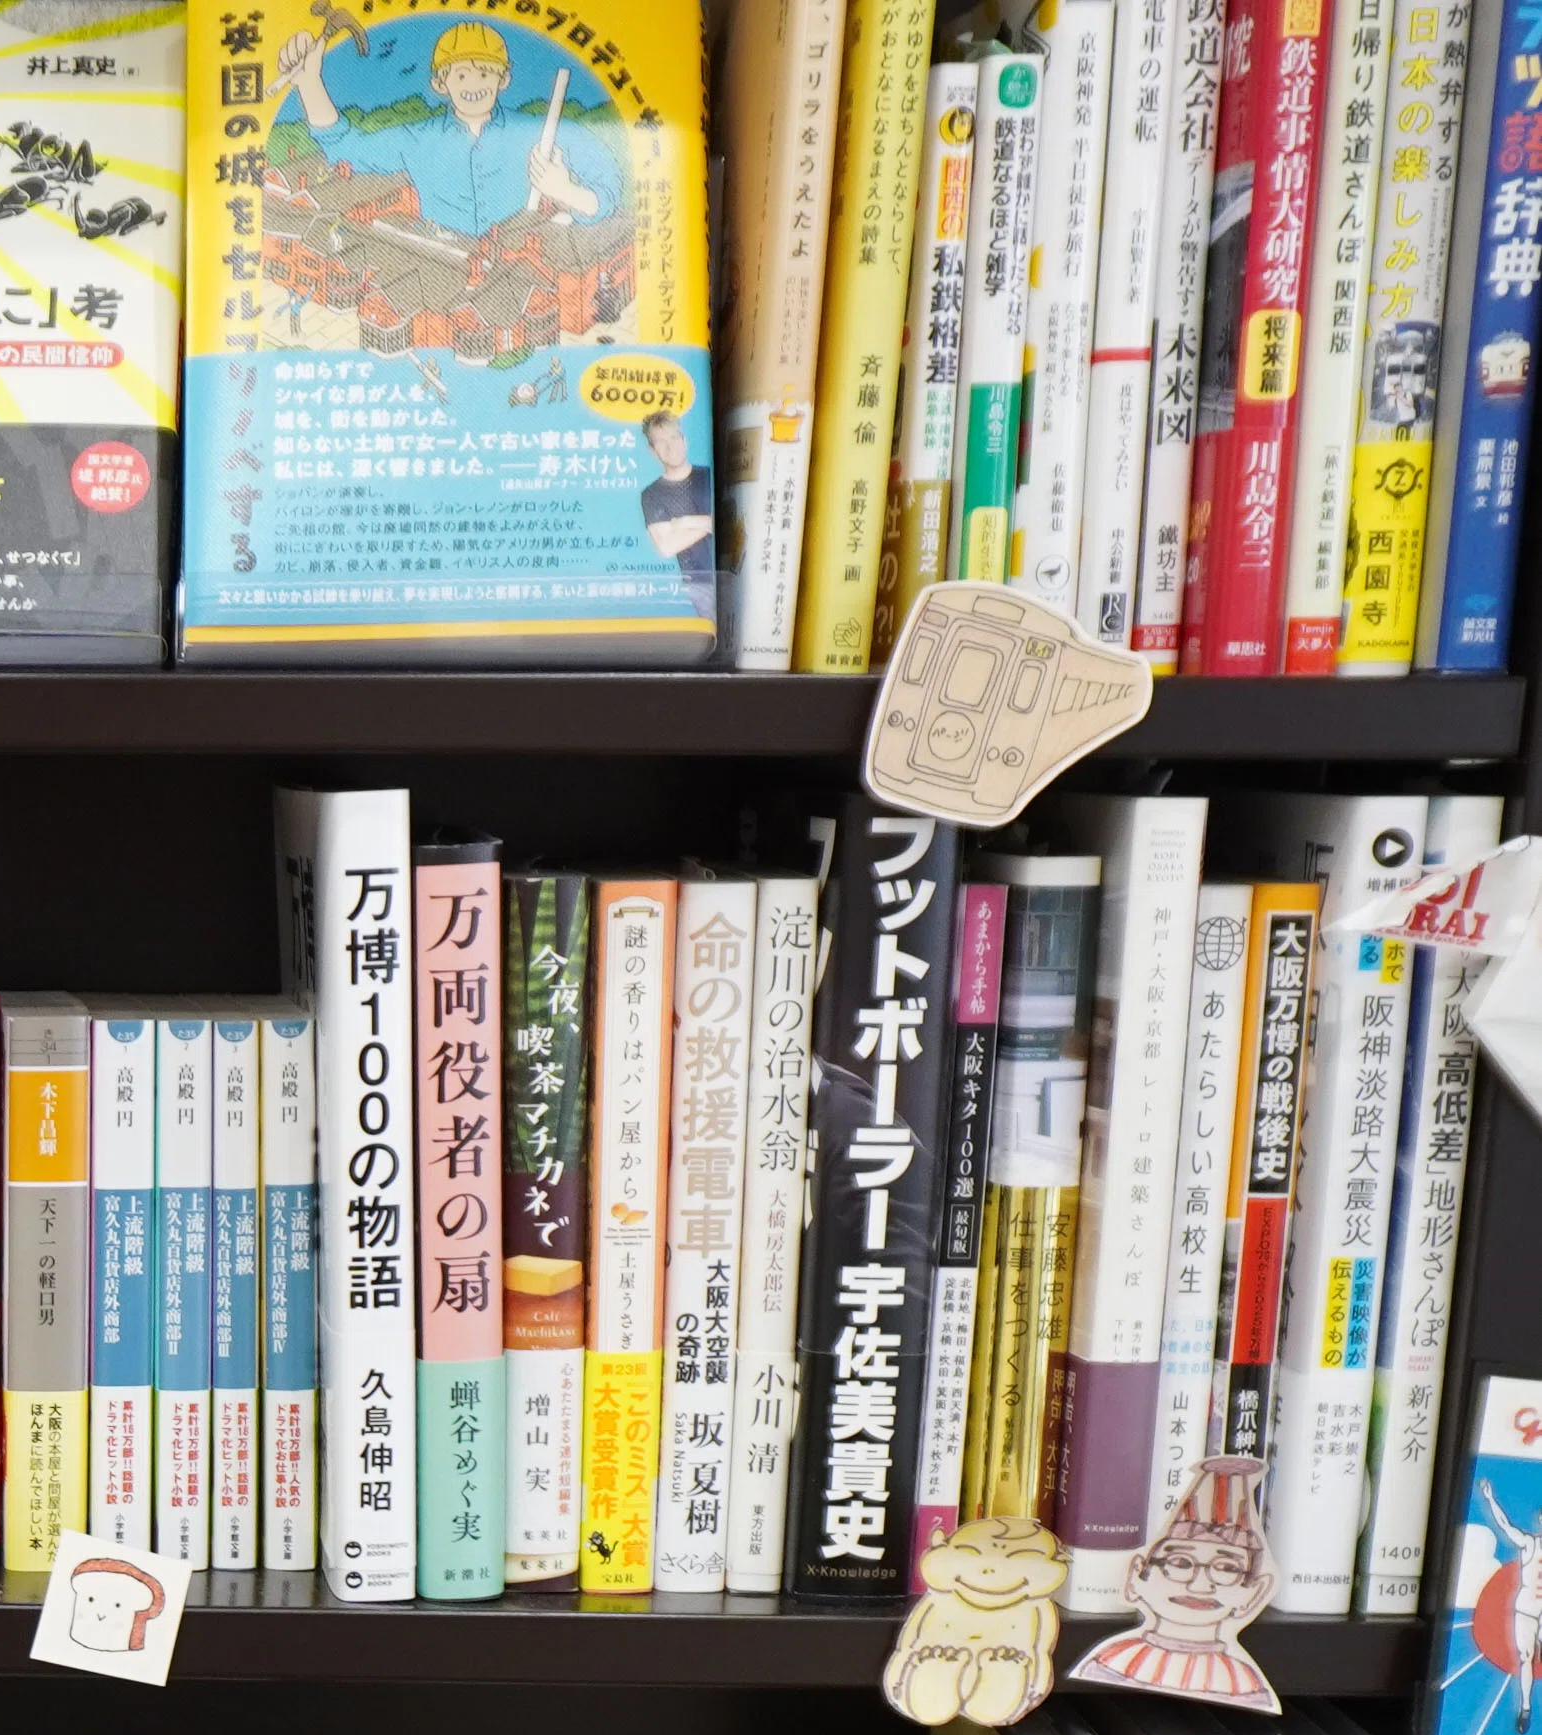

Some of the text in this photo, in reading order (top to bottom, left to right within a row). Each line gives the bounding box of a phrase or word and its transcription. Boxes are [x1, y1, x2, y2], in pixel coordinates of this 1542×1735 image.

[27, 55, 117, 78] 井上真史
[985, 118, 1017, 297] 鉄道なるほど雑学
[1263, 38, 1317, 305] 鉄道事情大研究
[215, 11, 265, 575] 英国の城をセルフリノベする
[924, 246, 965, 385] 私鉄格差
[1154, 324, 1200, 446] 未来図
[844, 479, 872, 553] 高野文子
[1242, 442, 1281, 569] 川島令三
[1361, 530, 1394, 625] 西園寺
[38, 1081, 58, 1158] 木下昌輝
[345, 868, 403, 1310] 万博100の物語
[426, 885, 492, 1316] 万両役者の扇
[619, 924, 649, 1200] 謎の香りはパン屋から
[680, 913, 748, 1259] 命の救援電車
[760, 906, 814, 1174] 淀川の治水翁
[1254, 918, 1308, 1181] 大阪万博の戦後史
[1343, 994, 1398, 1249] 阪神淡路大震災
[821, 816, 939, 1561] フットボーラー 宇佐美貴史
[1177, 991, 1227, 1296] あたらしい高校生
[37, 1198, 57, 1328] 天下一の軽口男
[705, 1259, 732, 1386] 大阪大空襲
[359, 1368, 393, 1511] 久島伸昭
[1402, 1383, 1435, 1463] 新之介
